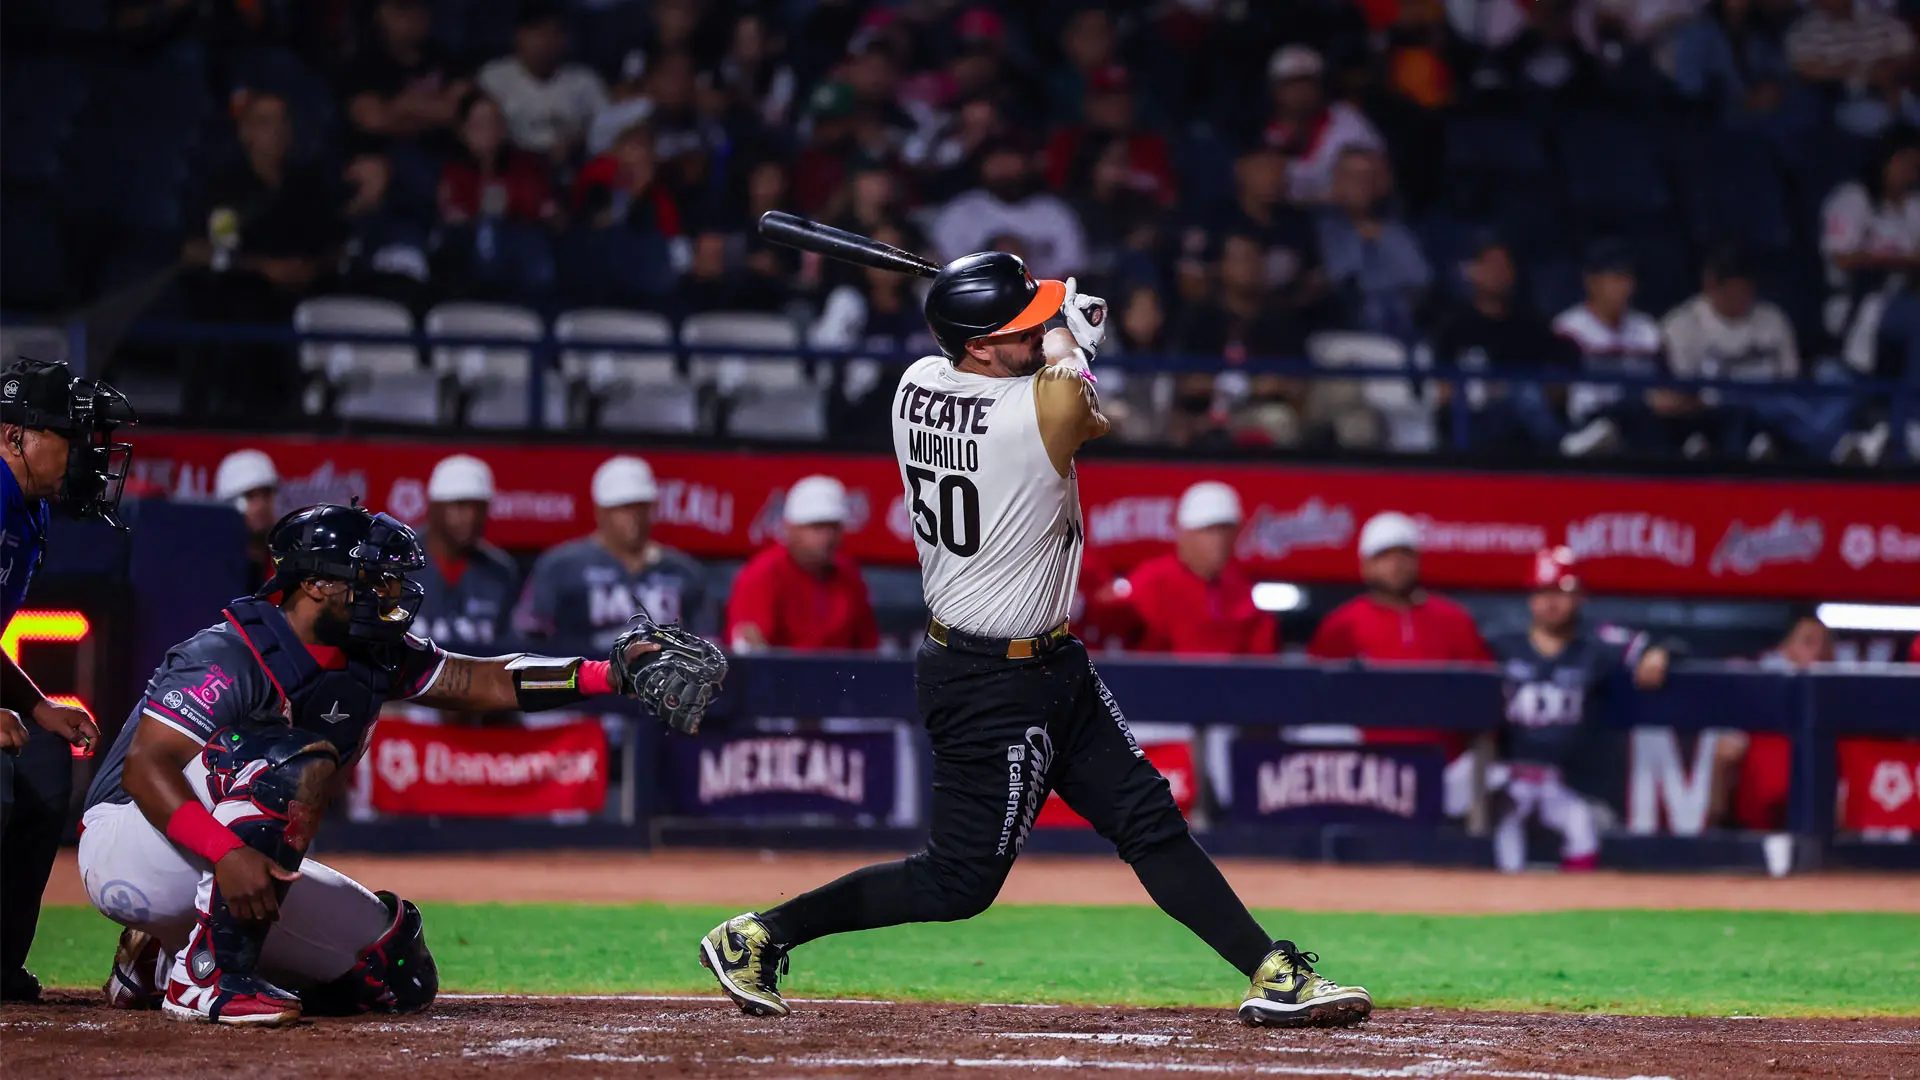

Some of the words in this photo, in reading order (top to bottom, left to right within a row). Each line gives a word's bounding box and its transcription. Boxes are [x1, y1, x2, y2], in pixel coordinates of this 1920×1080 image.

[900, 382, 996, 434] TECATE
[908, 428, 979, 472] MURILLO
[905, 463, 981, 558] 50
[1566, 511, 1695, 567] MEXICALI
[186, 711, 213, 734] Banamex
[424, 740, 599, 786] Banamex
[700, 738, 864, 802] MEXICALI
[1258, 754, 1415, 815] MEXICALI
[995, 762, 1025, 856] caliente.mx
